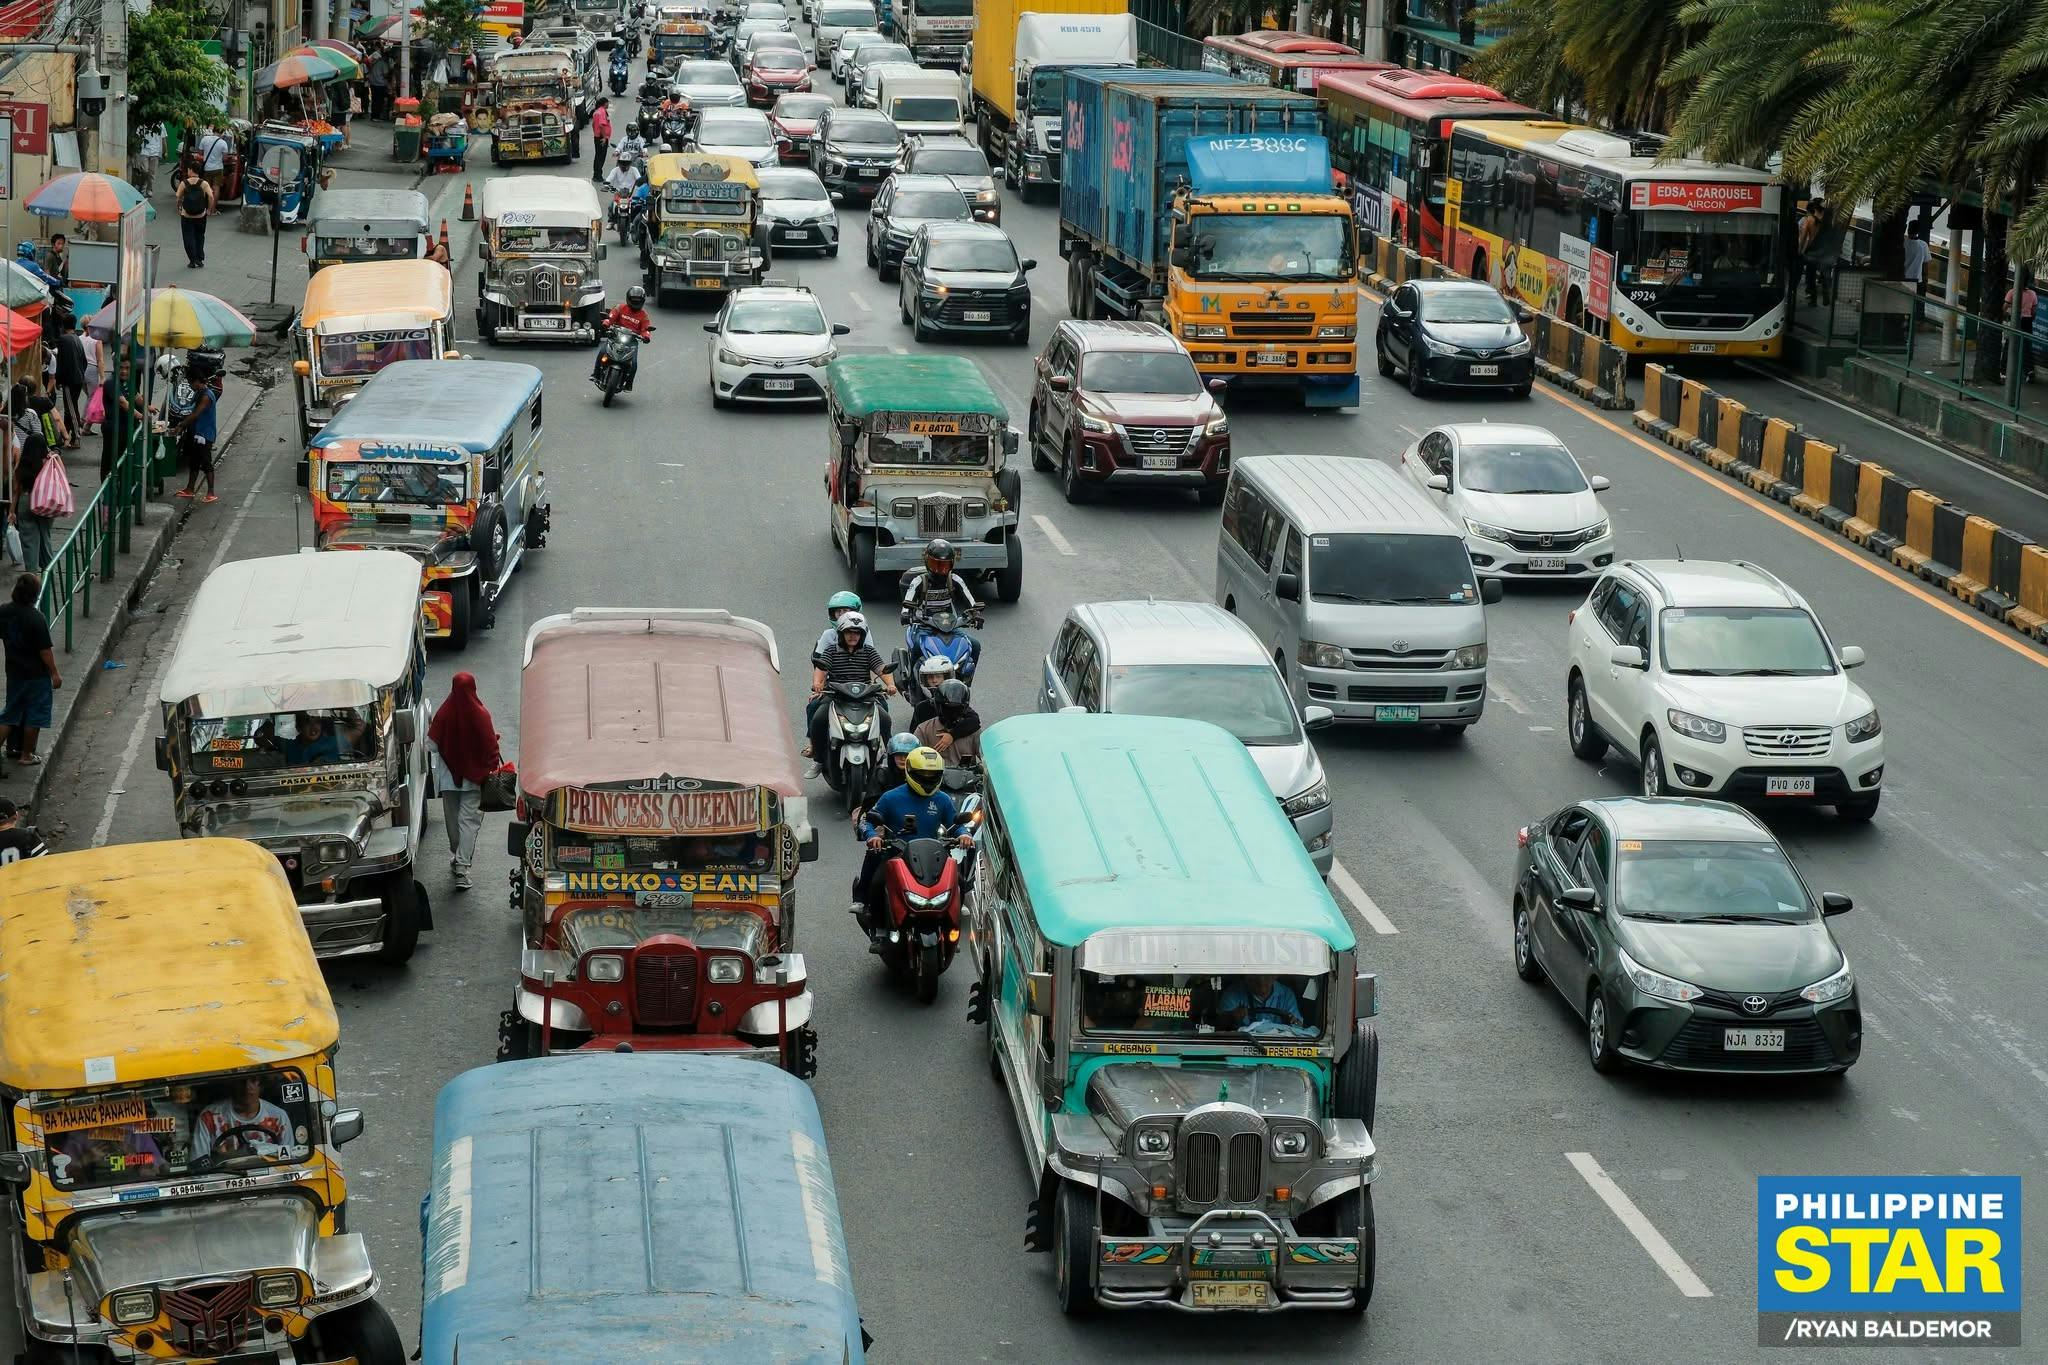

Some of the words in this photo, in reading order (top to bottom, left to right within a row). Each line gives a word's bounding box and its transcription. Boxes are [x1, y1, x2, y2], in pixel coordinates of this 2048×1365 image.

[695, 188, 741, 198] CEBU
[1632, 186, 1646, 205] E
[1657, 186, 1686, 198] EDSA
[1696, 187, 1754, 200] CAROUSEL
[1686, 200, 1726, 209] AIRCON
[1630, 290, 1656, 301] 8924
[324, 330, 426, 345] BOSSING
[1529, 559, 1542, 568] NDJ
[212, 739, 240, 750] EXPRESS
[281, 776, 313, 785] PASAY
[628, 779, 702, 791] JHO
[1771, 780, 1787, 790] PVQ
[1793, 780, 1810, 790] 698
[568, 788, 664, 828] PRINCESS
[668, 787, 757, 833] QUEENIE
[533, 828, 543, 869] NORA
[783, 829, 792, 871] JOHN
[569, 873, 661, 891] NICKO
[680, 874, 757, 892] SEAN
[1145, 986, 1176, 995] EXPRESS
[1145, 993, 1191, 1012] ALABANG
[1144, 1010, 1189, 1018] STARMALL
[1726, 1034, 1747, 1047] NJA
[1754, 1034, 1783, 1047] 8332
[1107, 1044, 1152, 1053] ALABANG
[45, 1111, 57, 1130] SA
[59, 1107, 98, 1127] TAMANG
[100, 1100, 144, 1121] PANAHON
[110, 1155, 125, 1171] SM
[170, 1184, 205, 1196] ALABANG
